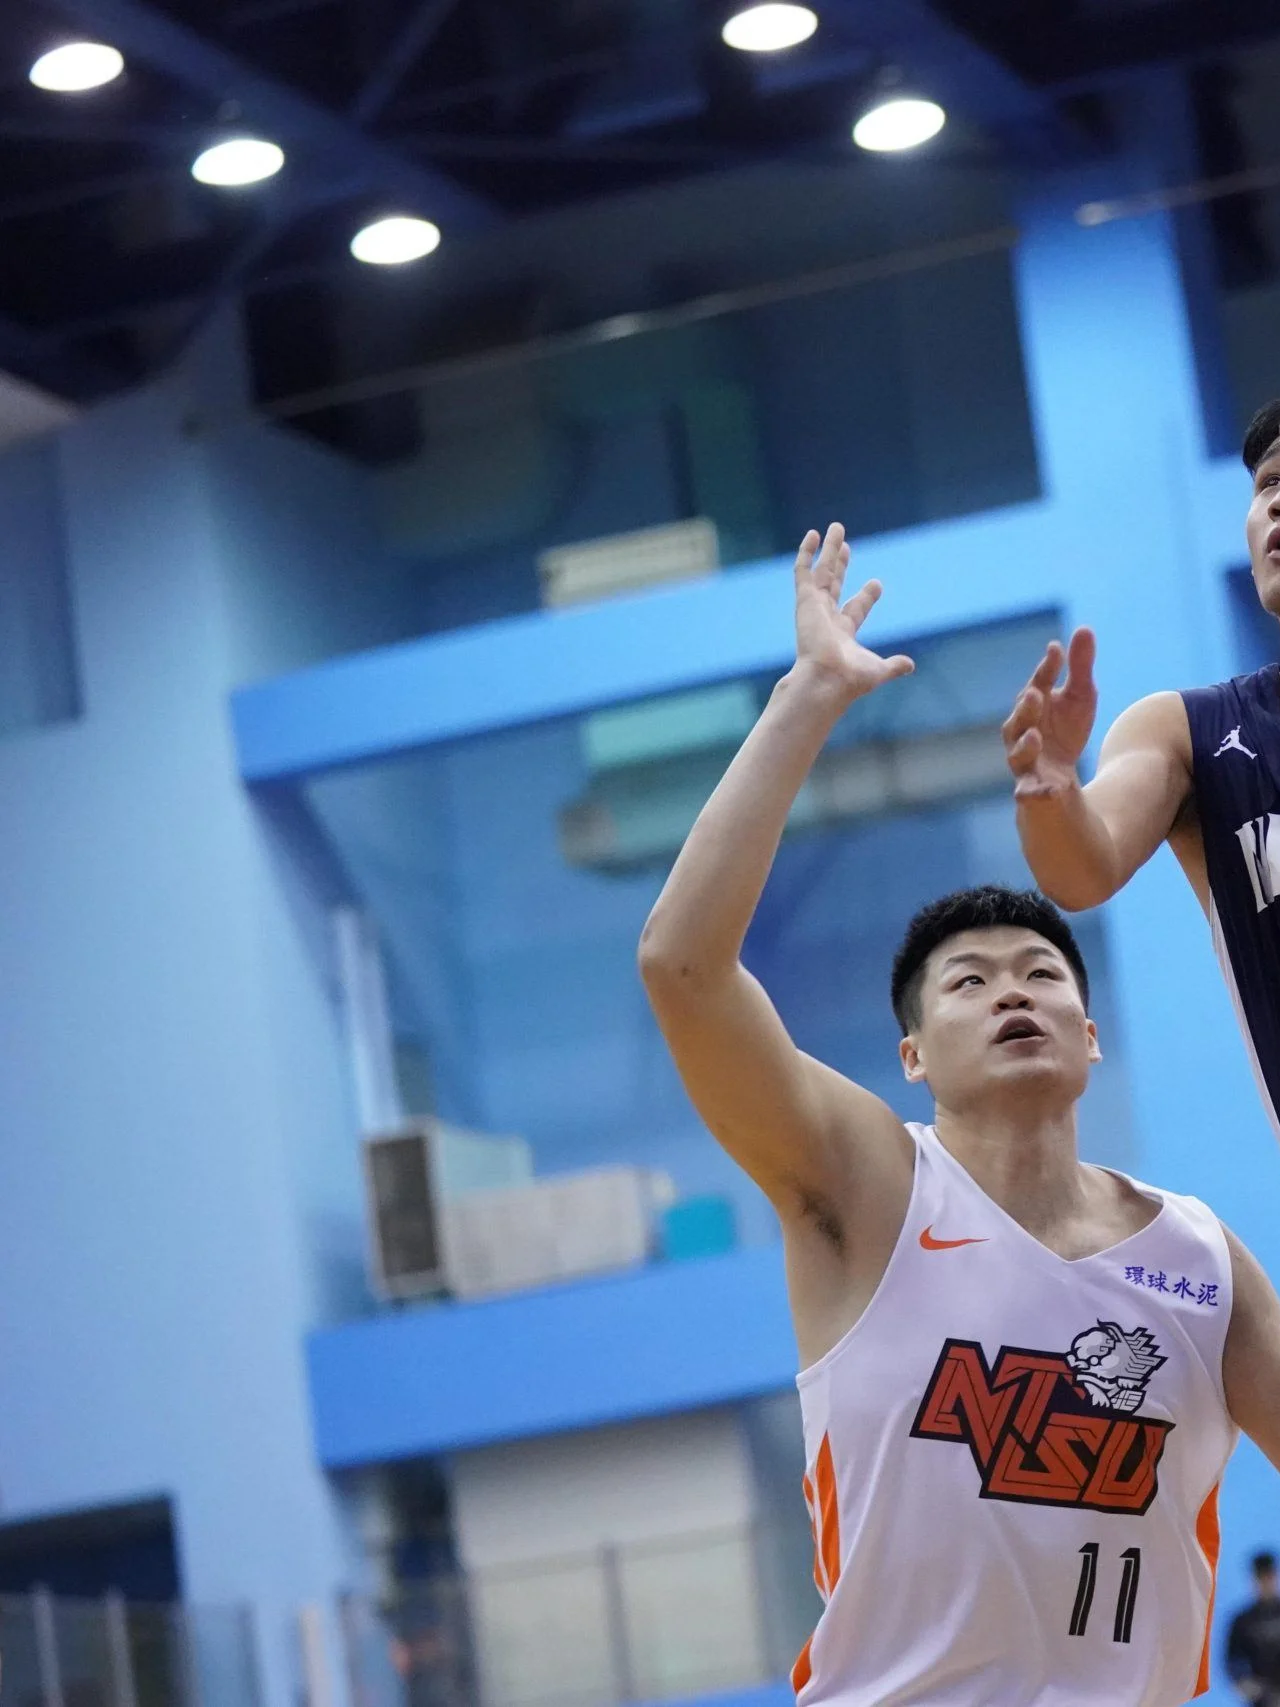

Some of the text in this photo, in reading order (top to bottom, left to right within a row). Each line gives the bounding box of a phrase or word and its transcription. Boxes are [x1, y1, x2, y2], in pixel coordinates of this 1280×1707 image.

[1123, 1265, 1220, 1308] 環球水泥
[909, 1337, 1177, 1517] NTSU
[1068, 1541, 1142, 1644] 11
